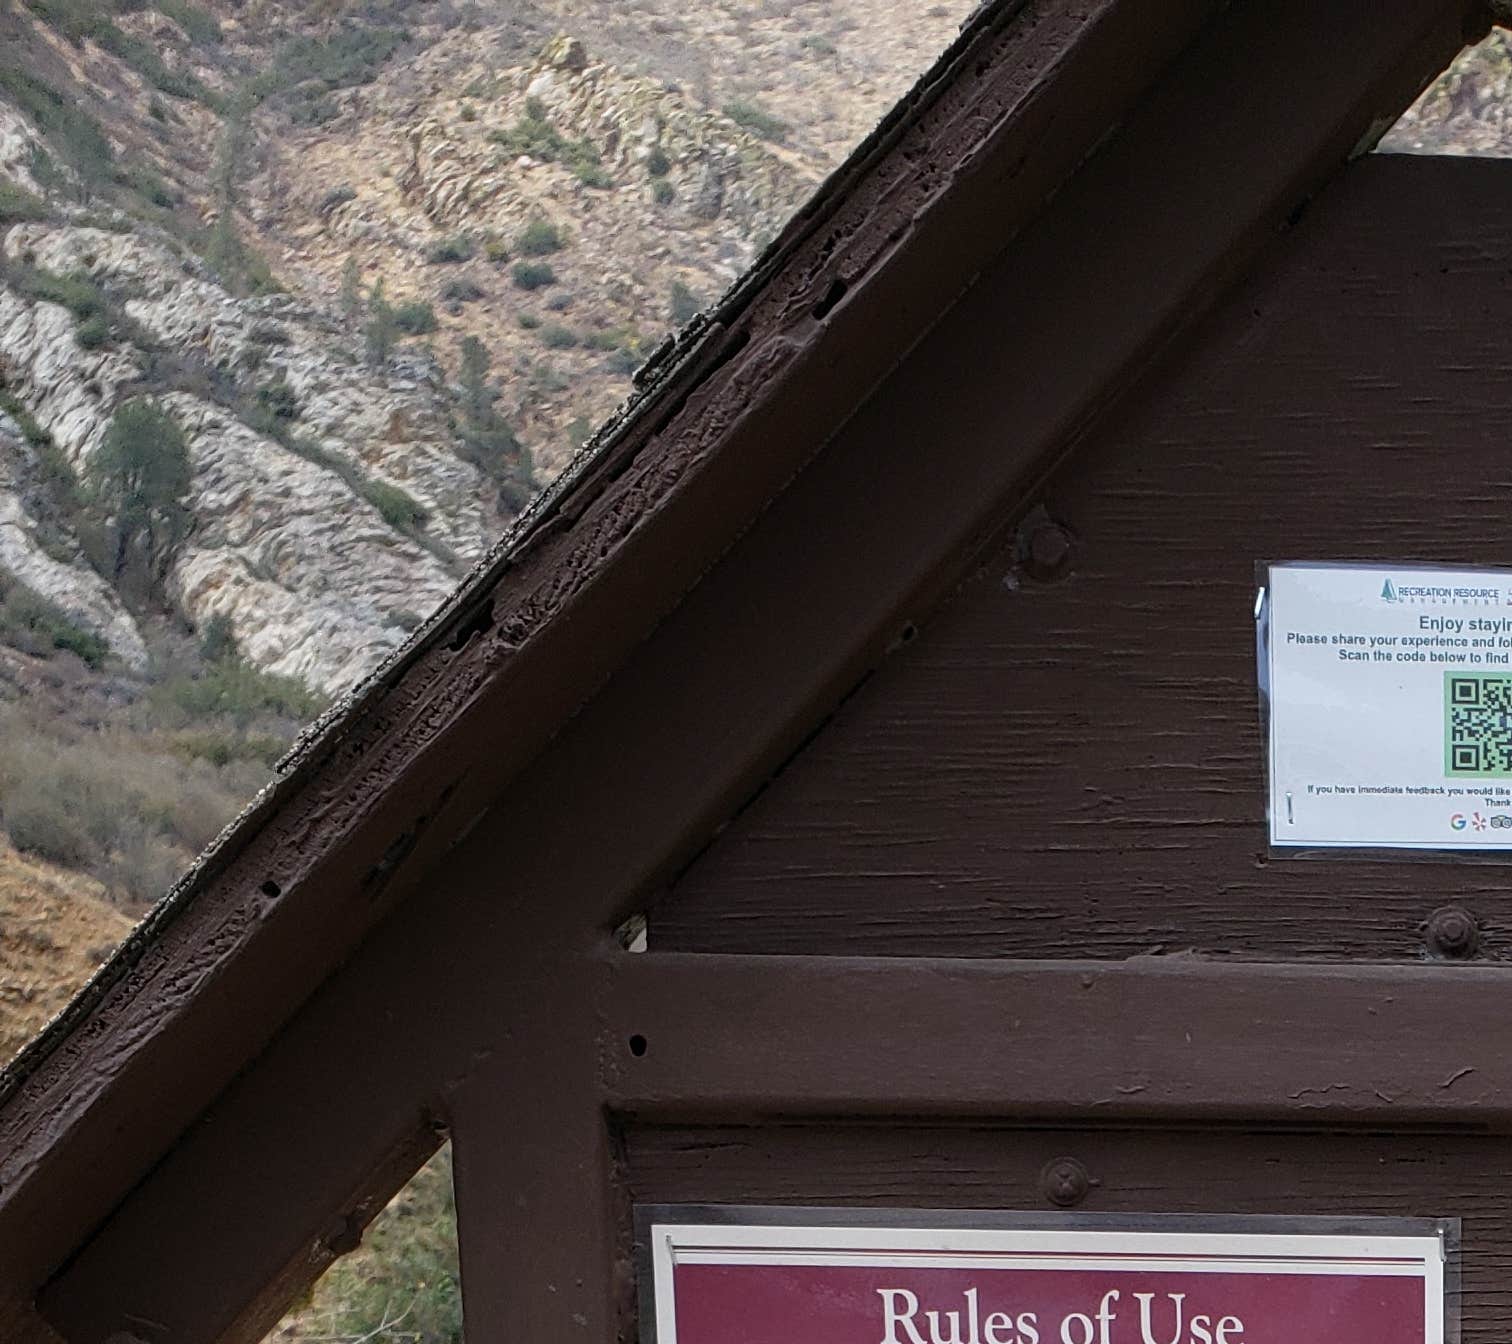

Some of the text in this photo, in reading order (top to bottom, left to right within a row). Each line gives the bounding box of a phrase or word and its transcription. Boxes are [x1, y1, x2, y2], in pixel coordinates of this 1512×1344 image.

[1397, 586, 1500, 600] RECREATION RESOURCE
[1418, 615, 1464, 634] Enjoy
[1286, 632, 1328, 645] Please
[1331, 633, 1366, 645] share
[1368, 636, 1399, 649] your
[1400, 635, 1468, 650] experience
[1471, 637, 1495, 647] and
[1338, 648, 1370, 661] Scan
[1372, 649, 1393, 661] the
[1395, 650, 1426, 662] code
[1429, 651, 1467, 663] below
[1469, 652, 1482, 663] to
[1484, 652, 1509, 664] find
[1484, 798, 1511, 807] Thank
